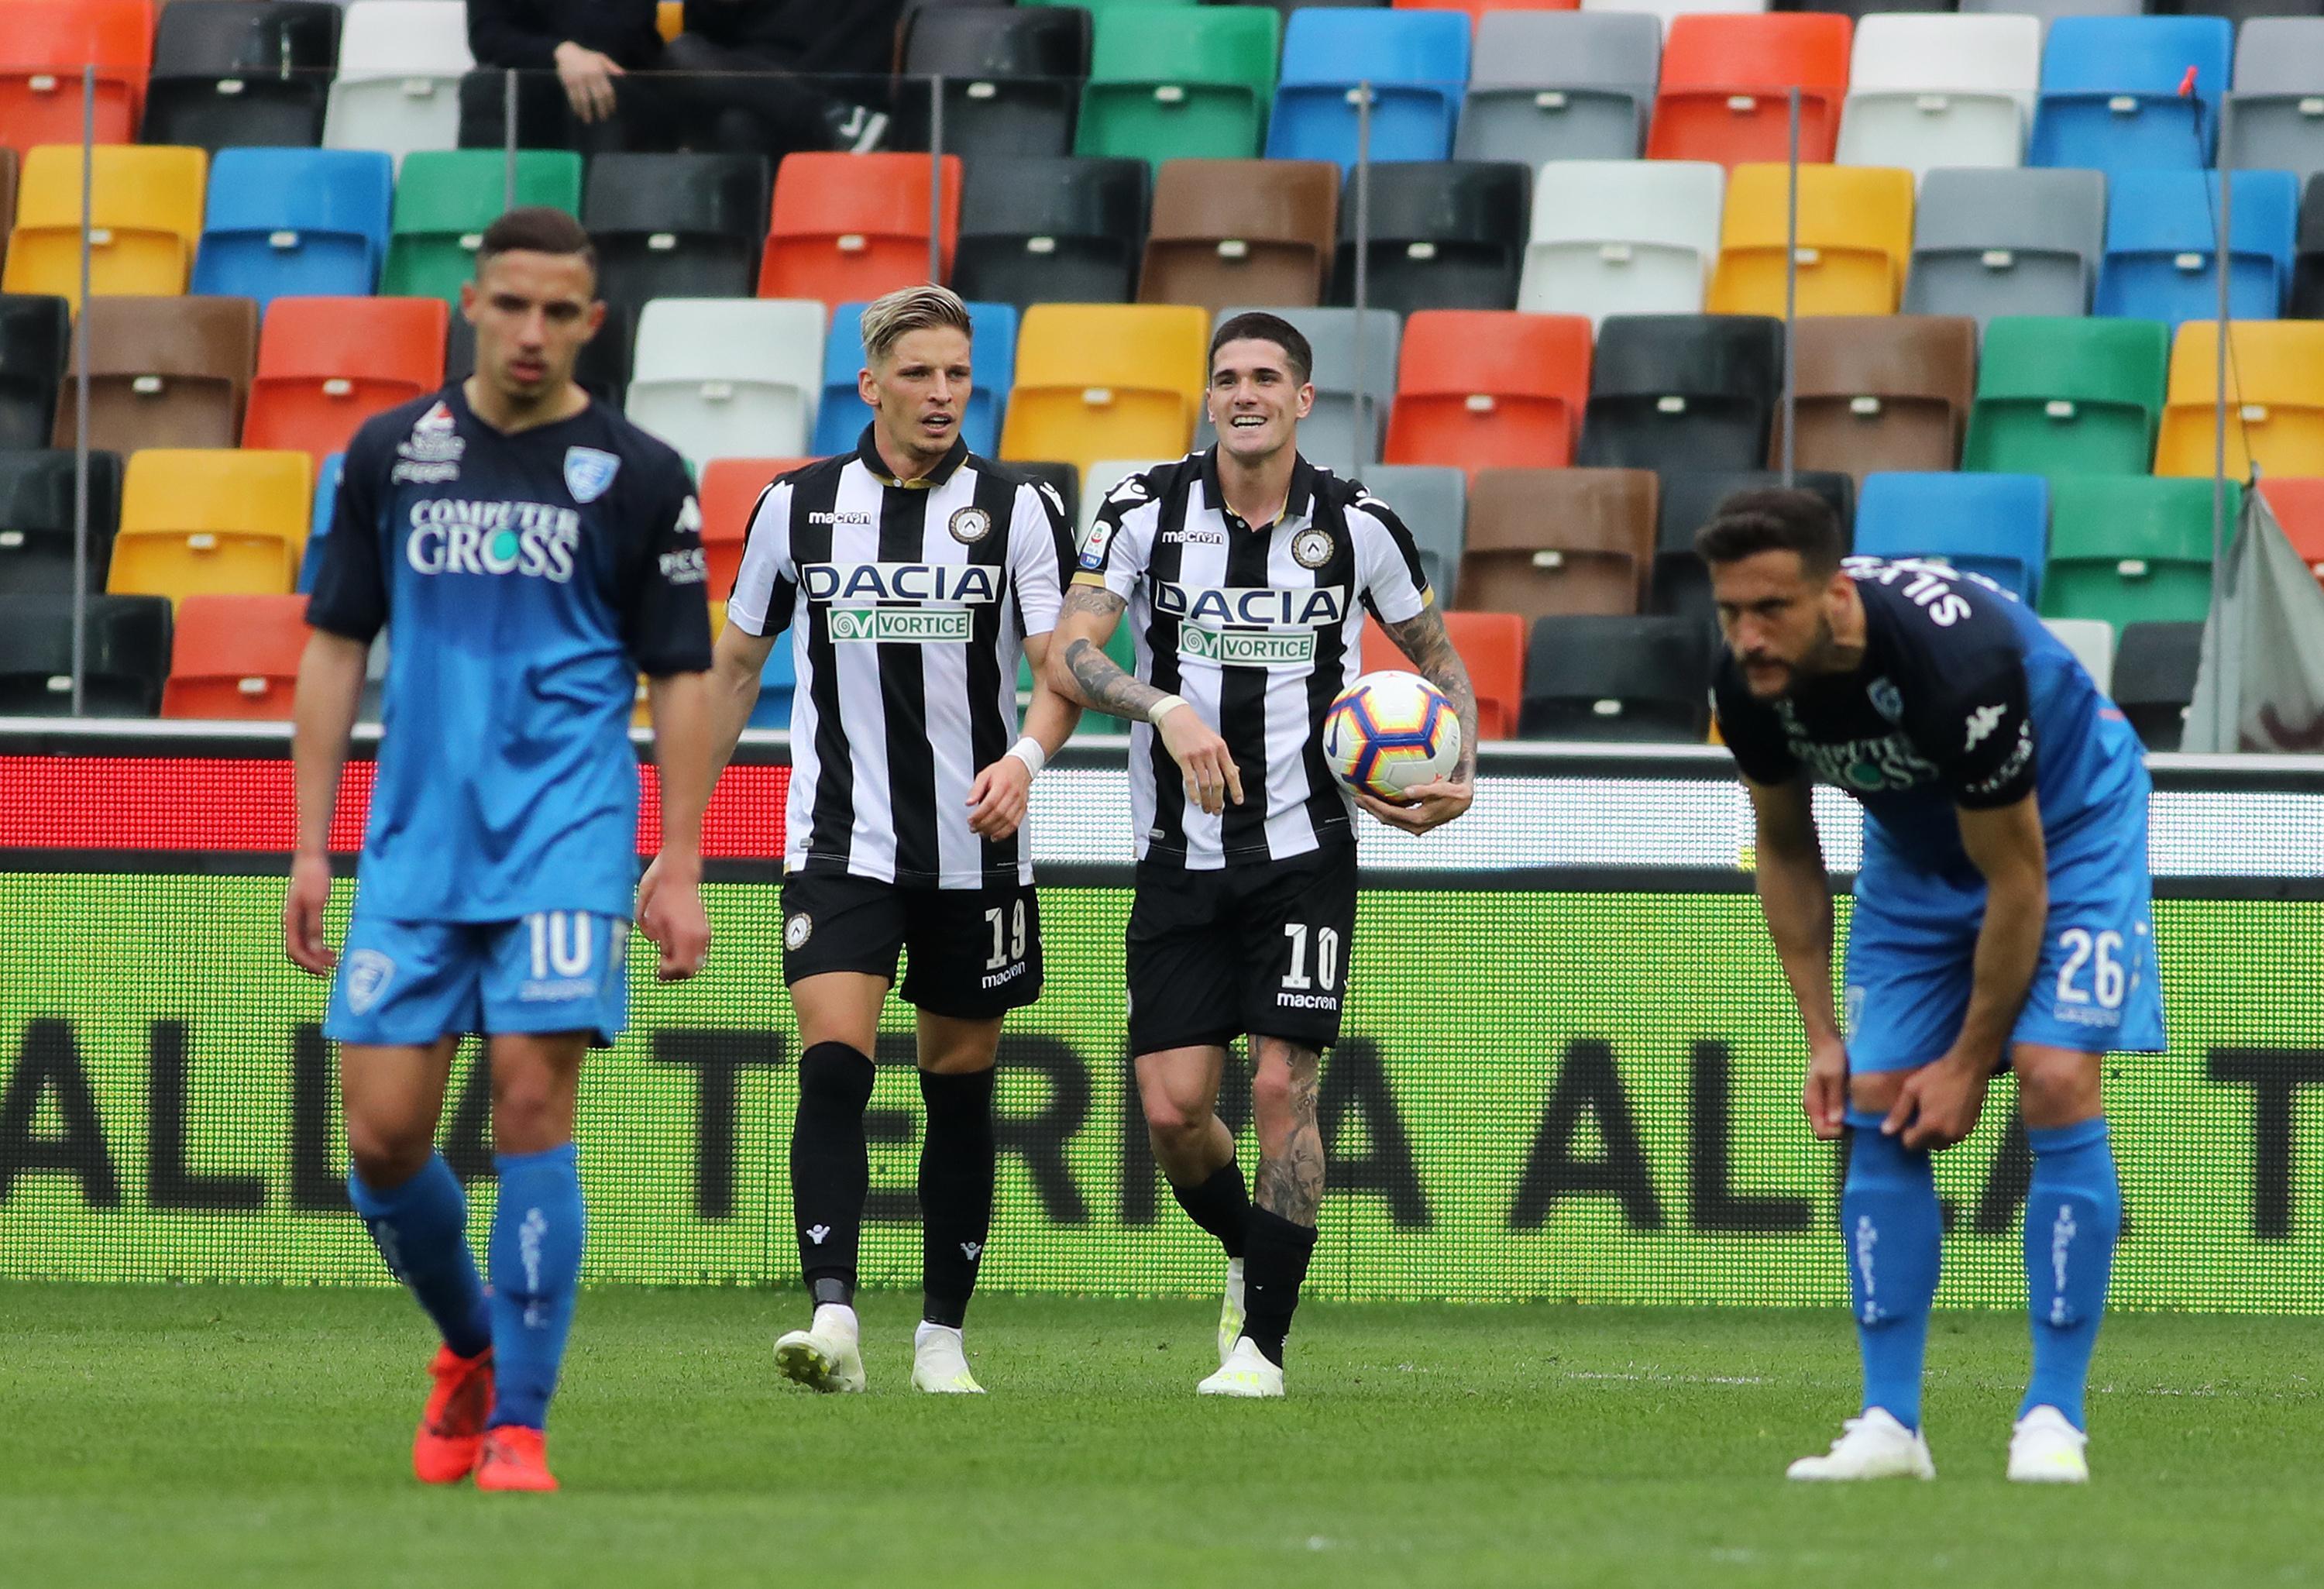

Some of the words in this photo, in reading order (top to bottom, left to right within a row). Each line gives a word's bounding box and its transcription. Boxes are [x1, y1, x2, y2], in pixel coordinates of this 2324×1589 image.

[809, 511, 871, 525] macron
[407, 522, 576, 583] GROSS
[1162, 530, 1223, 544] macron
[804, 564, 994, 600] DACIA
[1157, 584, 1339, 624] DACIA
[880, 616, 966, 634] VORTICE
[1225, 640, 1310, 657] VORTICE
[523, 911, 592, 979] 10
[985, 899, 1026, 971] 19
[982, 961, 1026, 990] macron
[1281, 923, 1339, 992] 10
[2057, 928, 2125, 1009] 26
[1277, 992, 1337, 1011] macron
